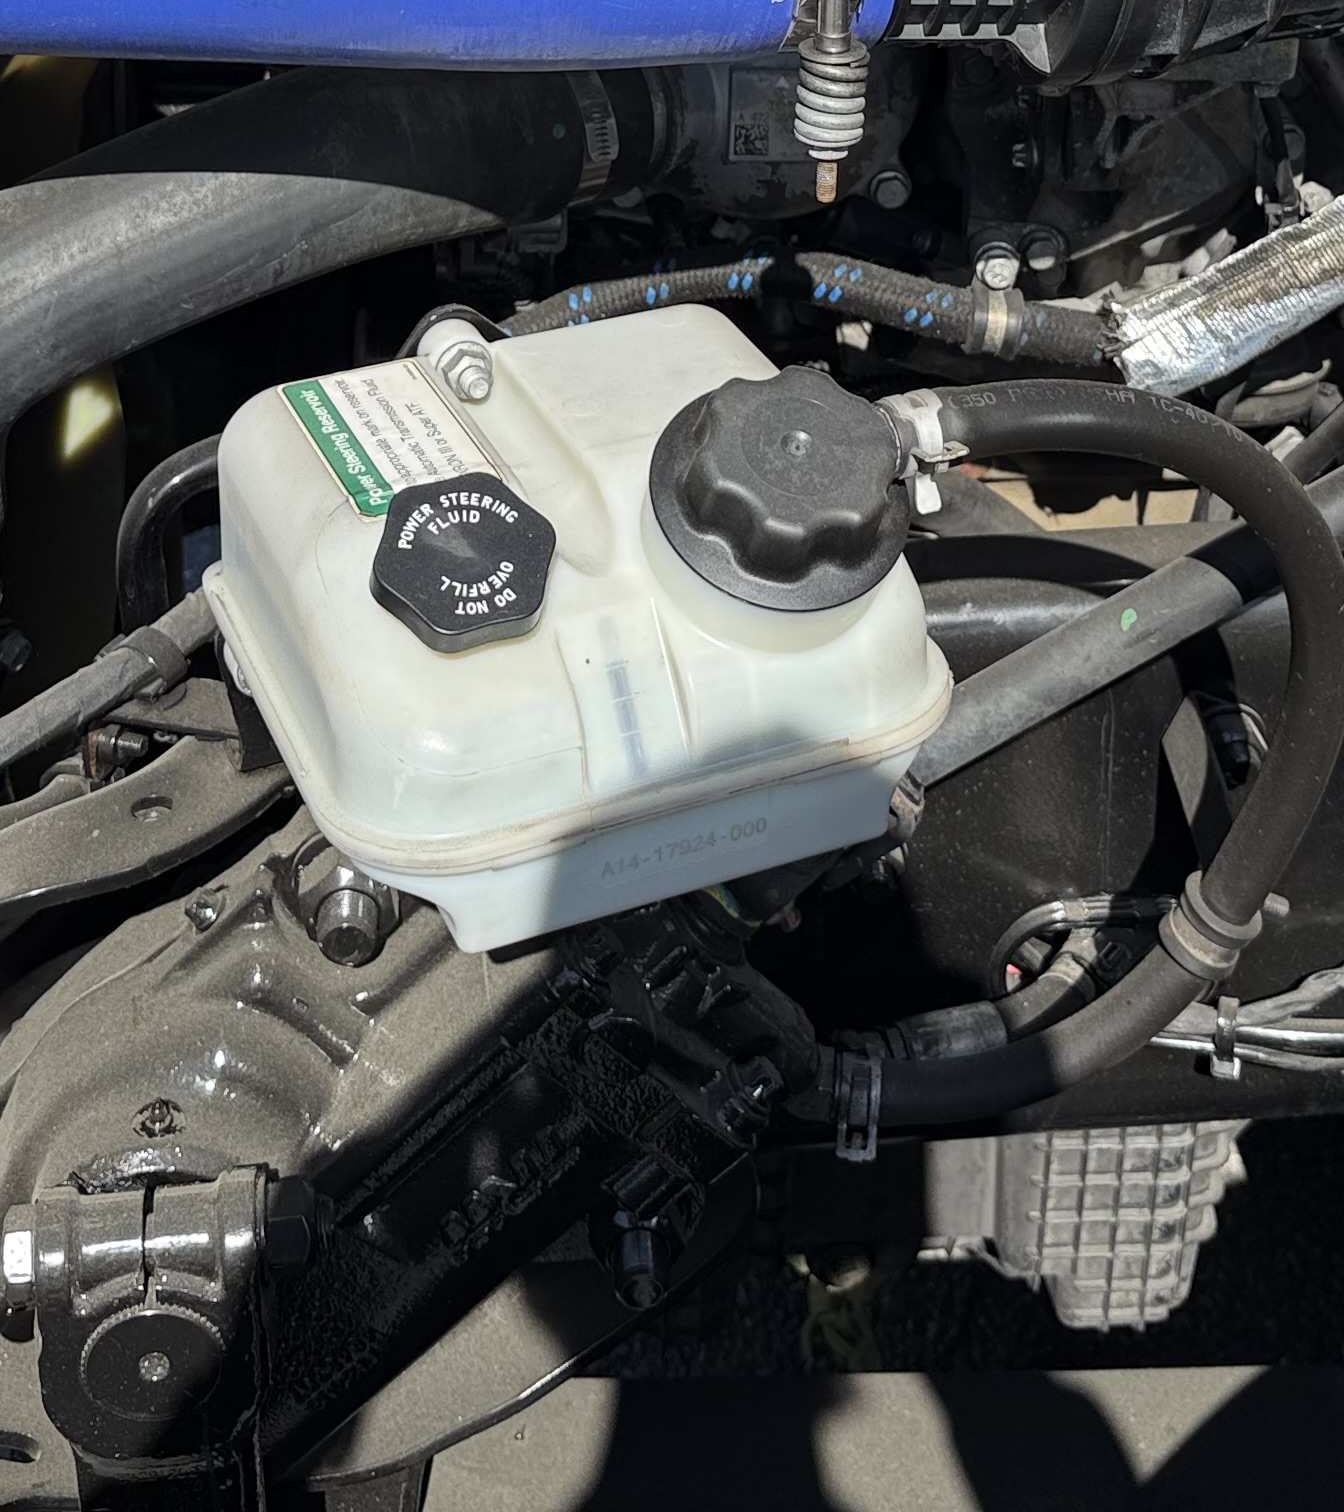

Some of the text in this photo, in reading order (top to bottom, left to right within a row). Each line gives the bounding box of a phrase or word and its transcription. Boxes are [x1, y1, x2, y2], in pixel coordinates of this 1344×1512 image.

[362, 377, 380, 399] Fluid
[375, 396, 410, 442] Transmission
[405, 402, 424, 420] ATF
[419, 414, 440, 437] Super
[301, 389, 387, 506] Power Steering Reservoir
[358, 408, 411, 481] appropriate mark on
[408, 441, 438, 476] Automatic
[435, 436, 446, 446] or
[398, 492, 518, 549] POWER STEERING
[427, 509, 481, 535] FLUID
[439, 561, 514, 598] OVERFILL
[454, 588, 517, 615] DO NOT
[600, 817, 768, 879] A14-17924-000
